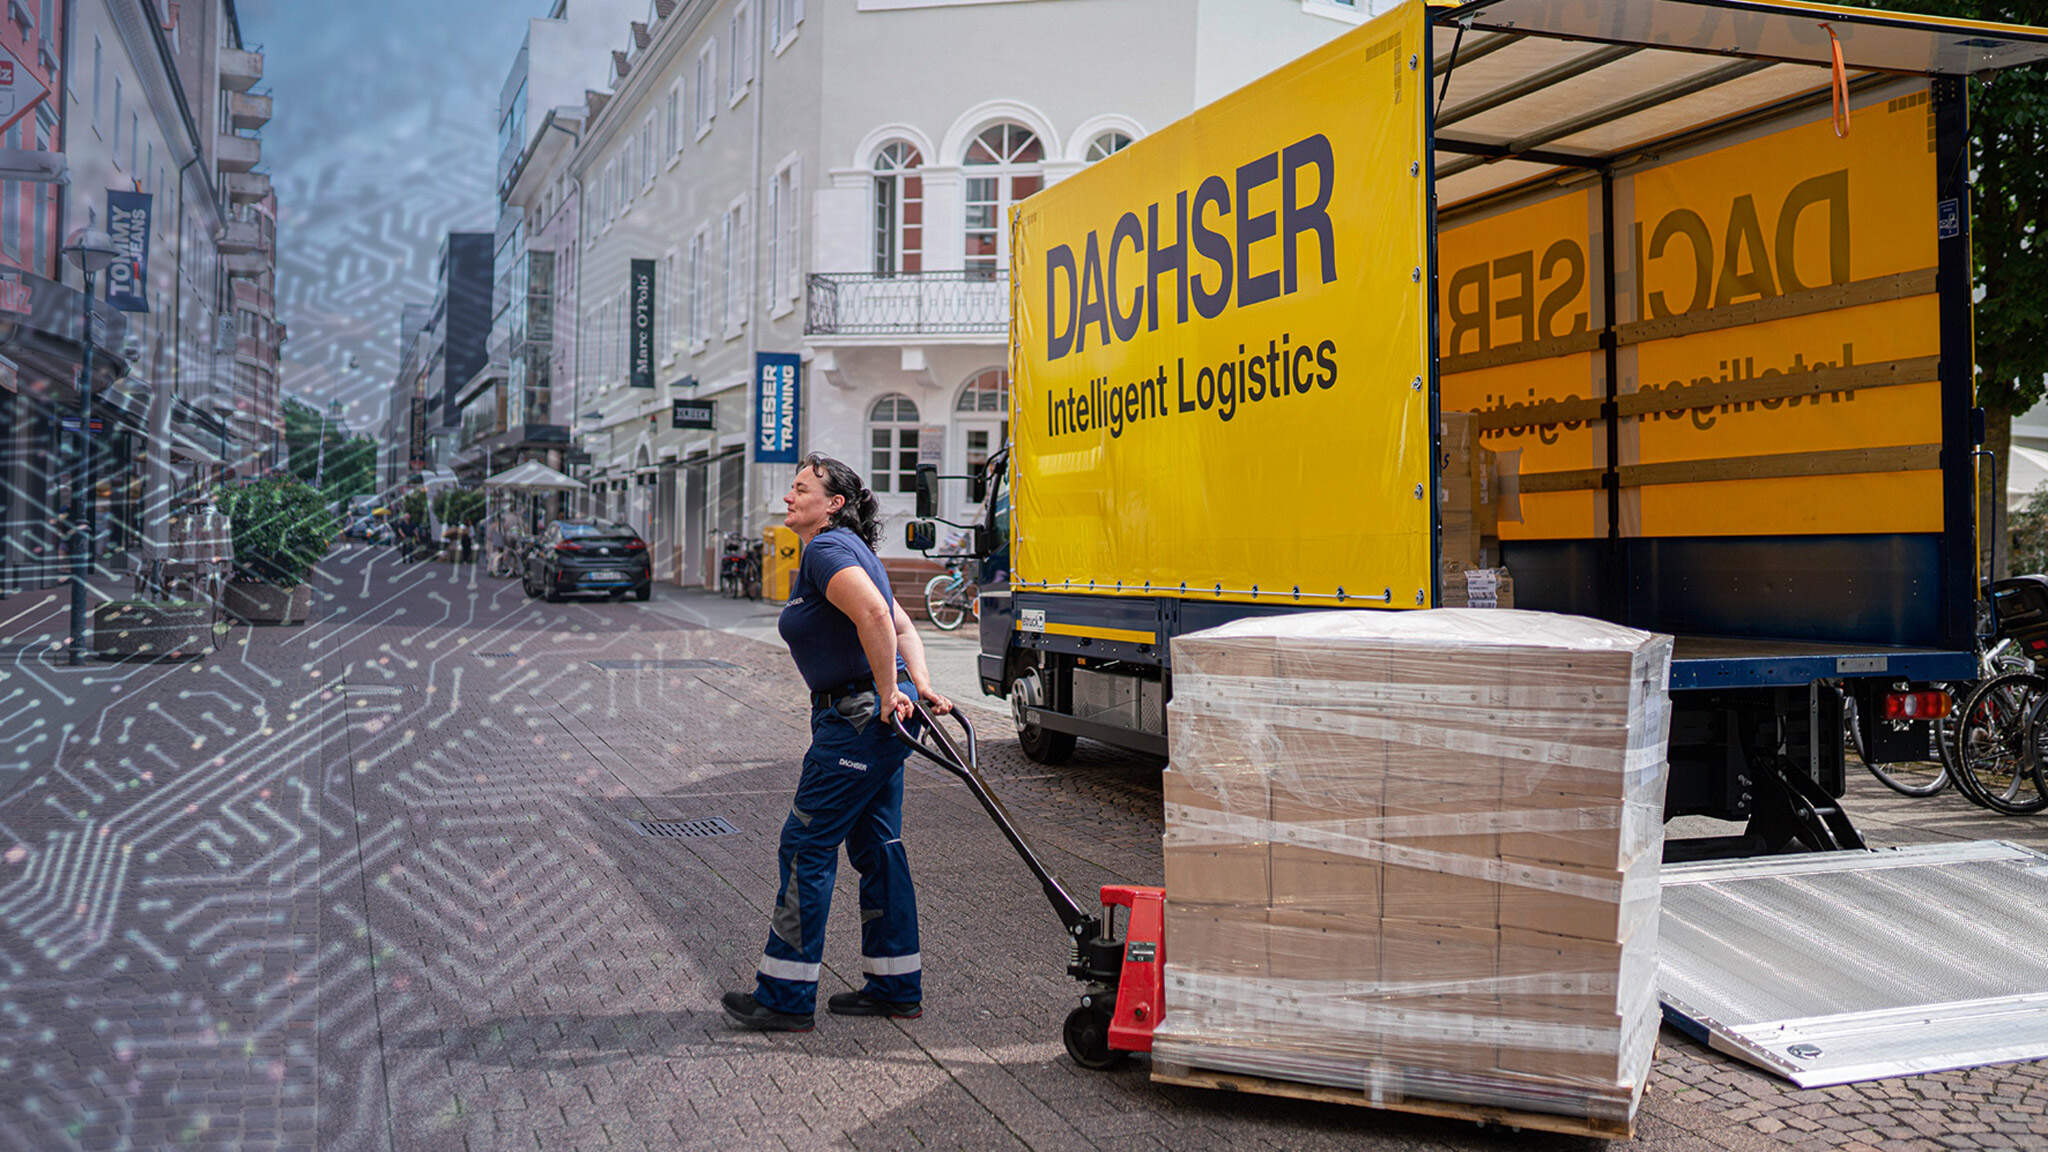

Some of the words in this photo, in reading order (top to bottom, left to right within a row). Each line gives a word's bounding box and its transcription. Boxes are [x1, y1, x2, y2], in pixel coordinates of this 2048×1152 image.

[110, 205, 131, 297] TOMMY
[130, 208, 147, 262] JEANS
[1046, 133, 1338, 361] DACHSER
[636, 331, 649, 374] Marc
[1047, 365, 1168, 439] Intelligent
[1178, 333, 1338, 422] Logistics
[761, 364, 777, 452] KIESER
[780, 364, 795, 452] TRAINING
[838, 757, 868, 772] DACHSER
